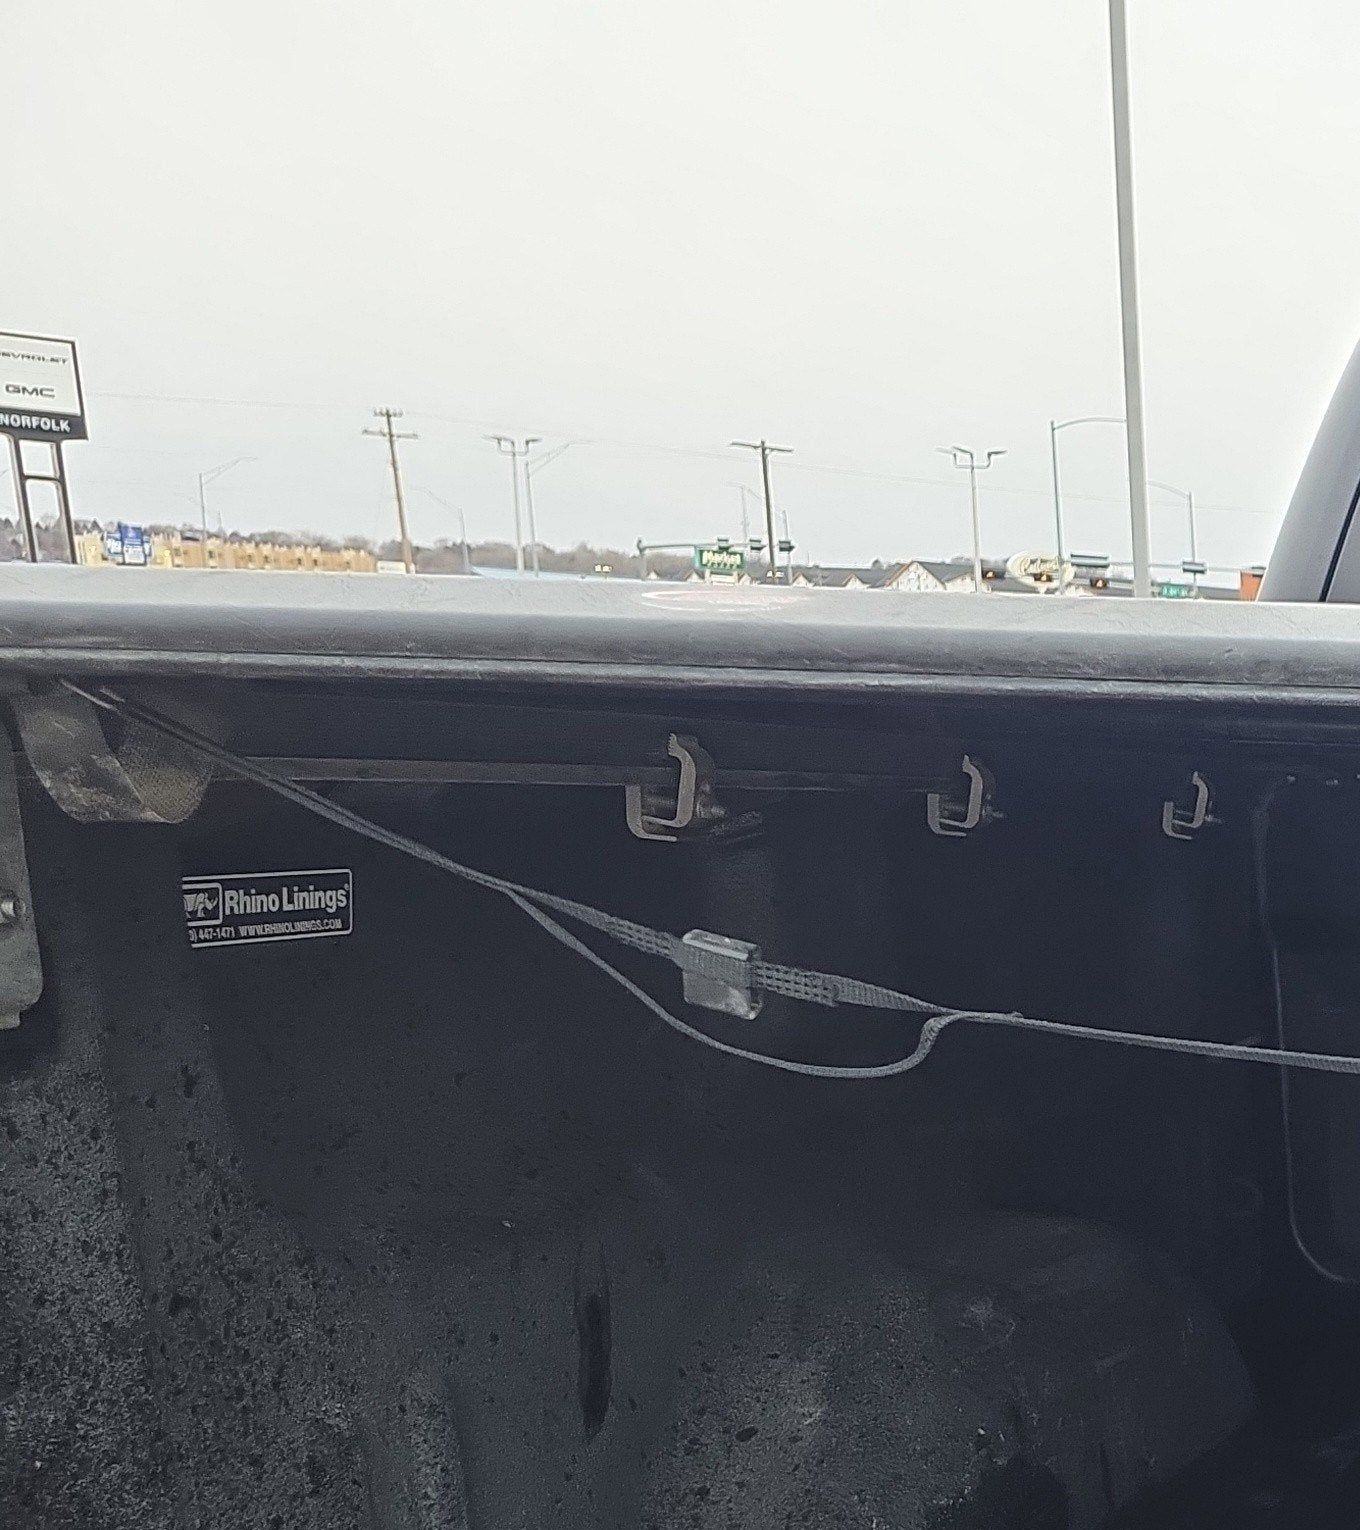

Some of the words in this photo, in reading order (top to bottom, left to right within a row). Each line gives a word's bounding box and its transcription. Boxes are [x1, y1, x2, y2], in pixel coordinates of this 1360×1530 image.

[5, 383, 55, 398] GMC
[0, 412, 71, 433] NORFOLK
[224, 888, 280, 915] Rhino
